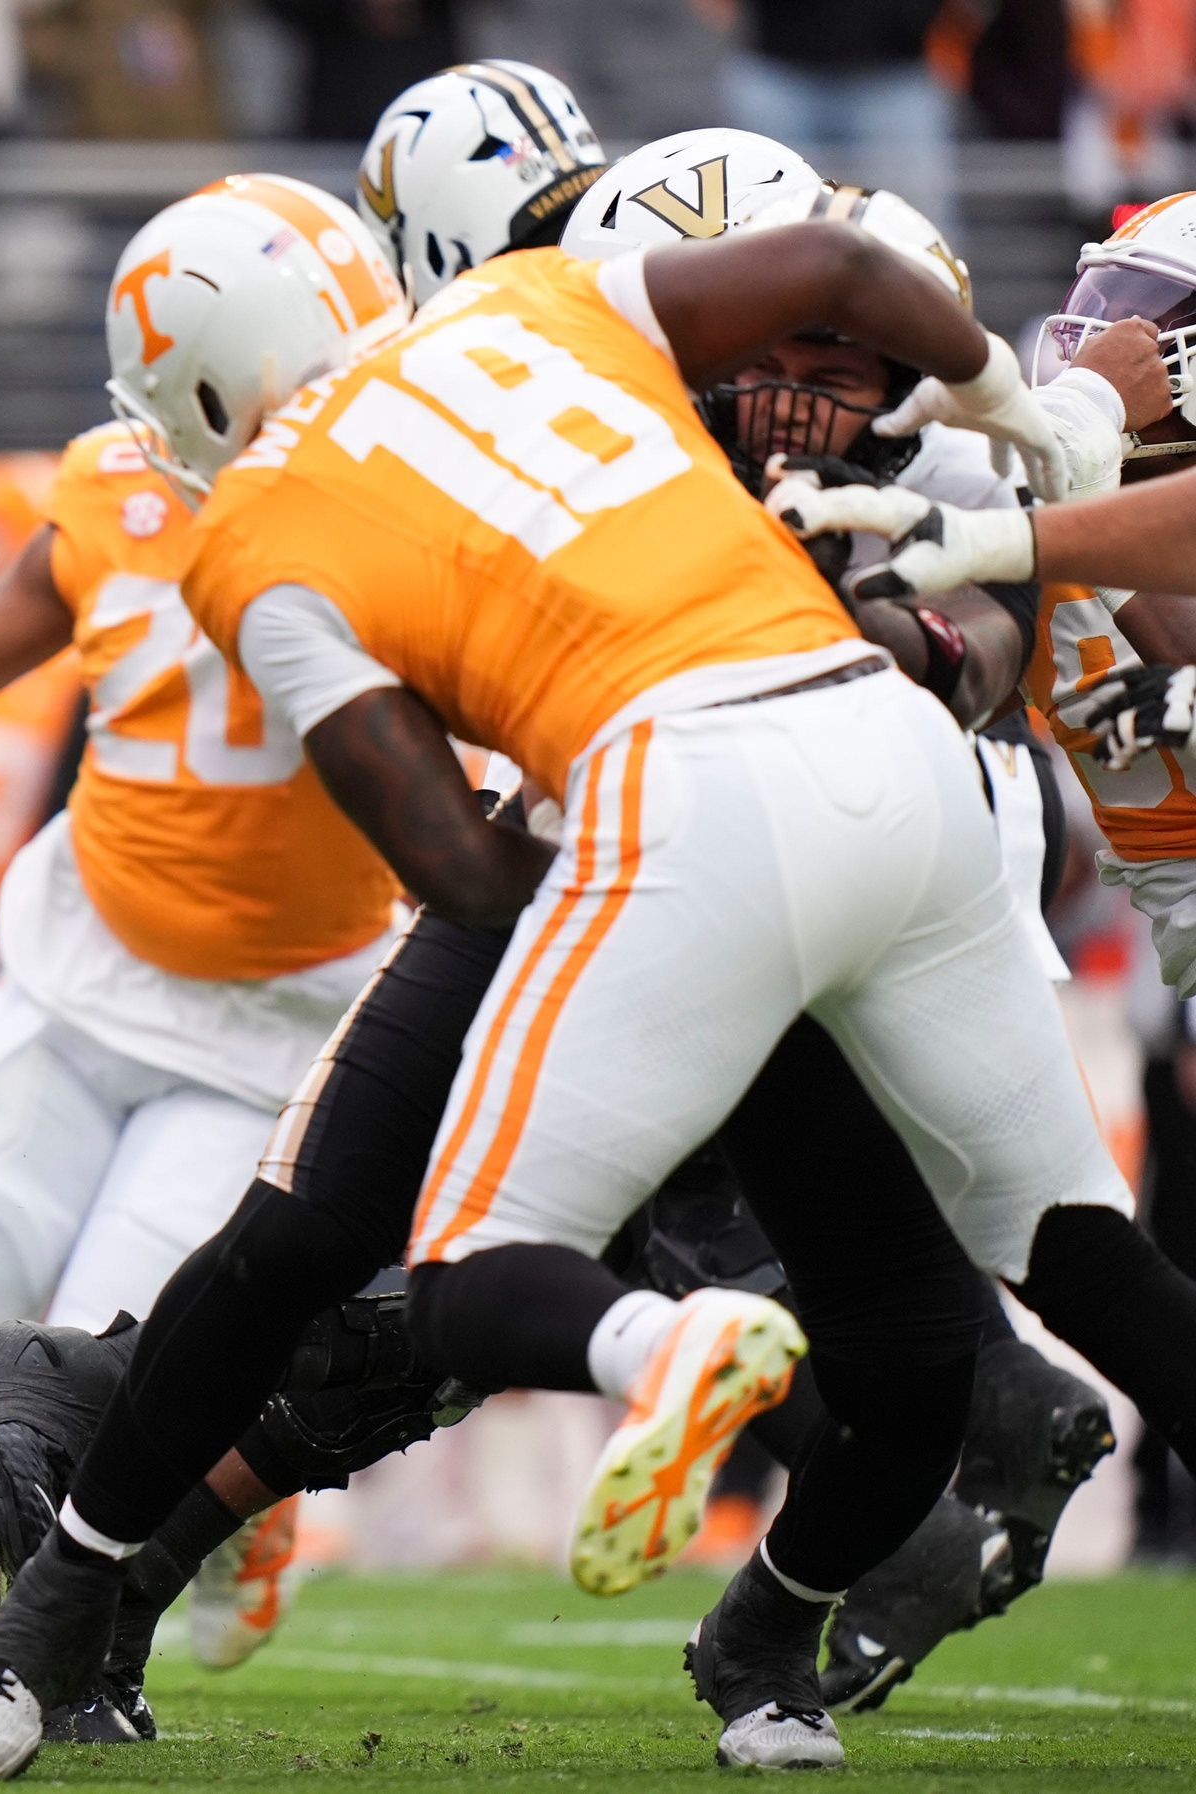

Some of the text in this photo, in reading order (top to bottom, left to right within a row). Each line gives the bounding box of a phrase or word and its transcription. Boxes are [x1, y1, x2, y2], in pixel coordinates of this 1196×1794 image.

[358, 132, 398, 223] V
[626, 154, 729, 238] V
[114, 247, 176, 366] T
[327, 313, 693, 562] 18
[86, 572, 304, 785] 20
